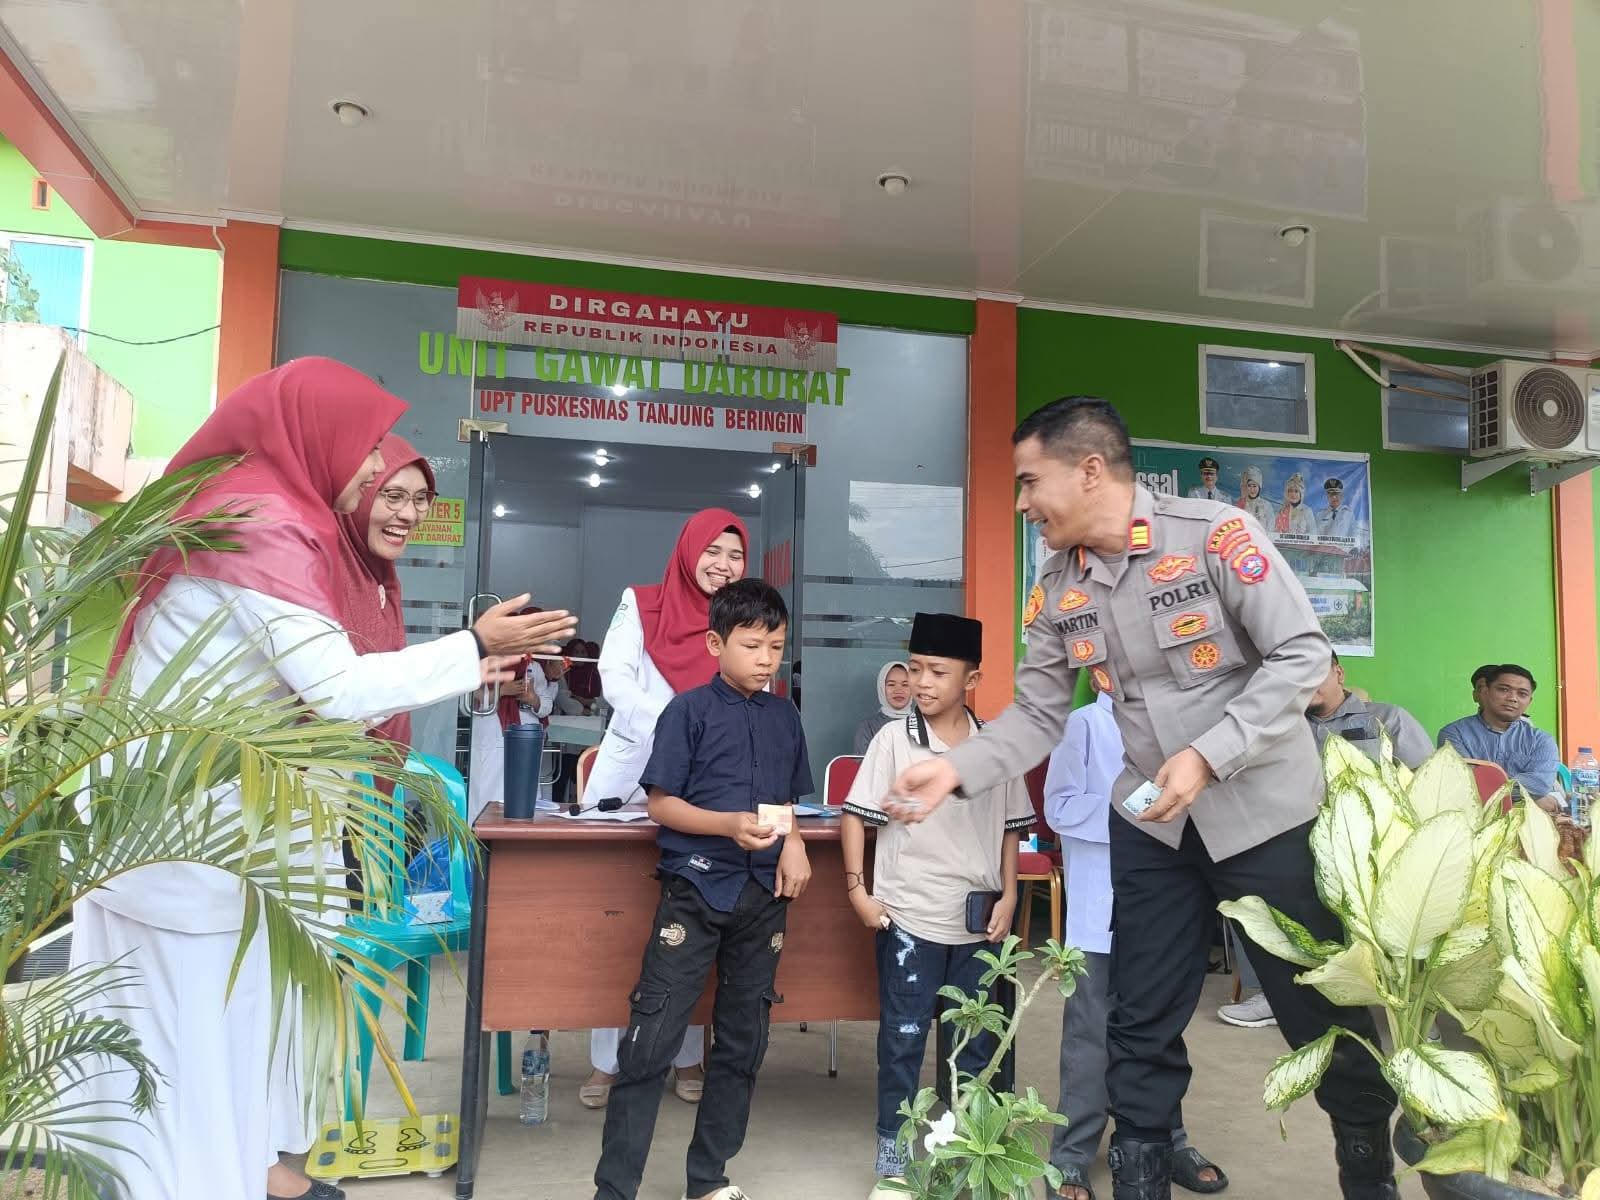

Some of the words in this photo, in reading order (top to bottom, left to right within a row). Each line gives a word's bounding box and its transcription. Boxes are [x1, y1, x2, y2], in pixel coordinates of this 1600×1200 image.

[549, 294, 749, 328] DIRGAHAYU
[523, 320, 643, 344] REPUBLIK
[652, 333, 779, 354] INDONESIA
[418, 331, 512, 379] UNIT
[534, 346, 661, 392] GAWAT
[684, 355, 851, 406] DARURAT
[479, 390, 515, 414] UPT
[521, 392, 629, 421] PUSKESMAS
[637, 402, 715, 428] TANJUNG
[725, 408, 804, 434] BERINGIN
[429, 502, 451, 519] TER
[454, 503, 461, 520] 5
[415, 523, 452, 532] LAYANAN
[427, 534, 462, 543] DARURAT
[1149, 580, 1211, 611] POLRI
[1055, 612, 1098, 634] MARTIN
